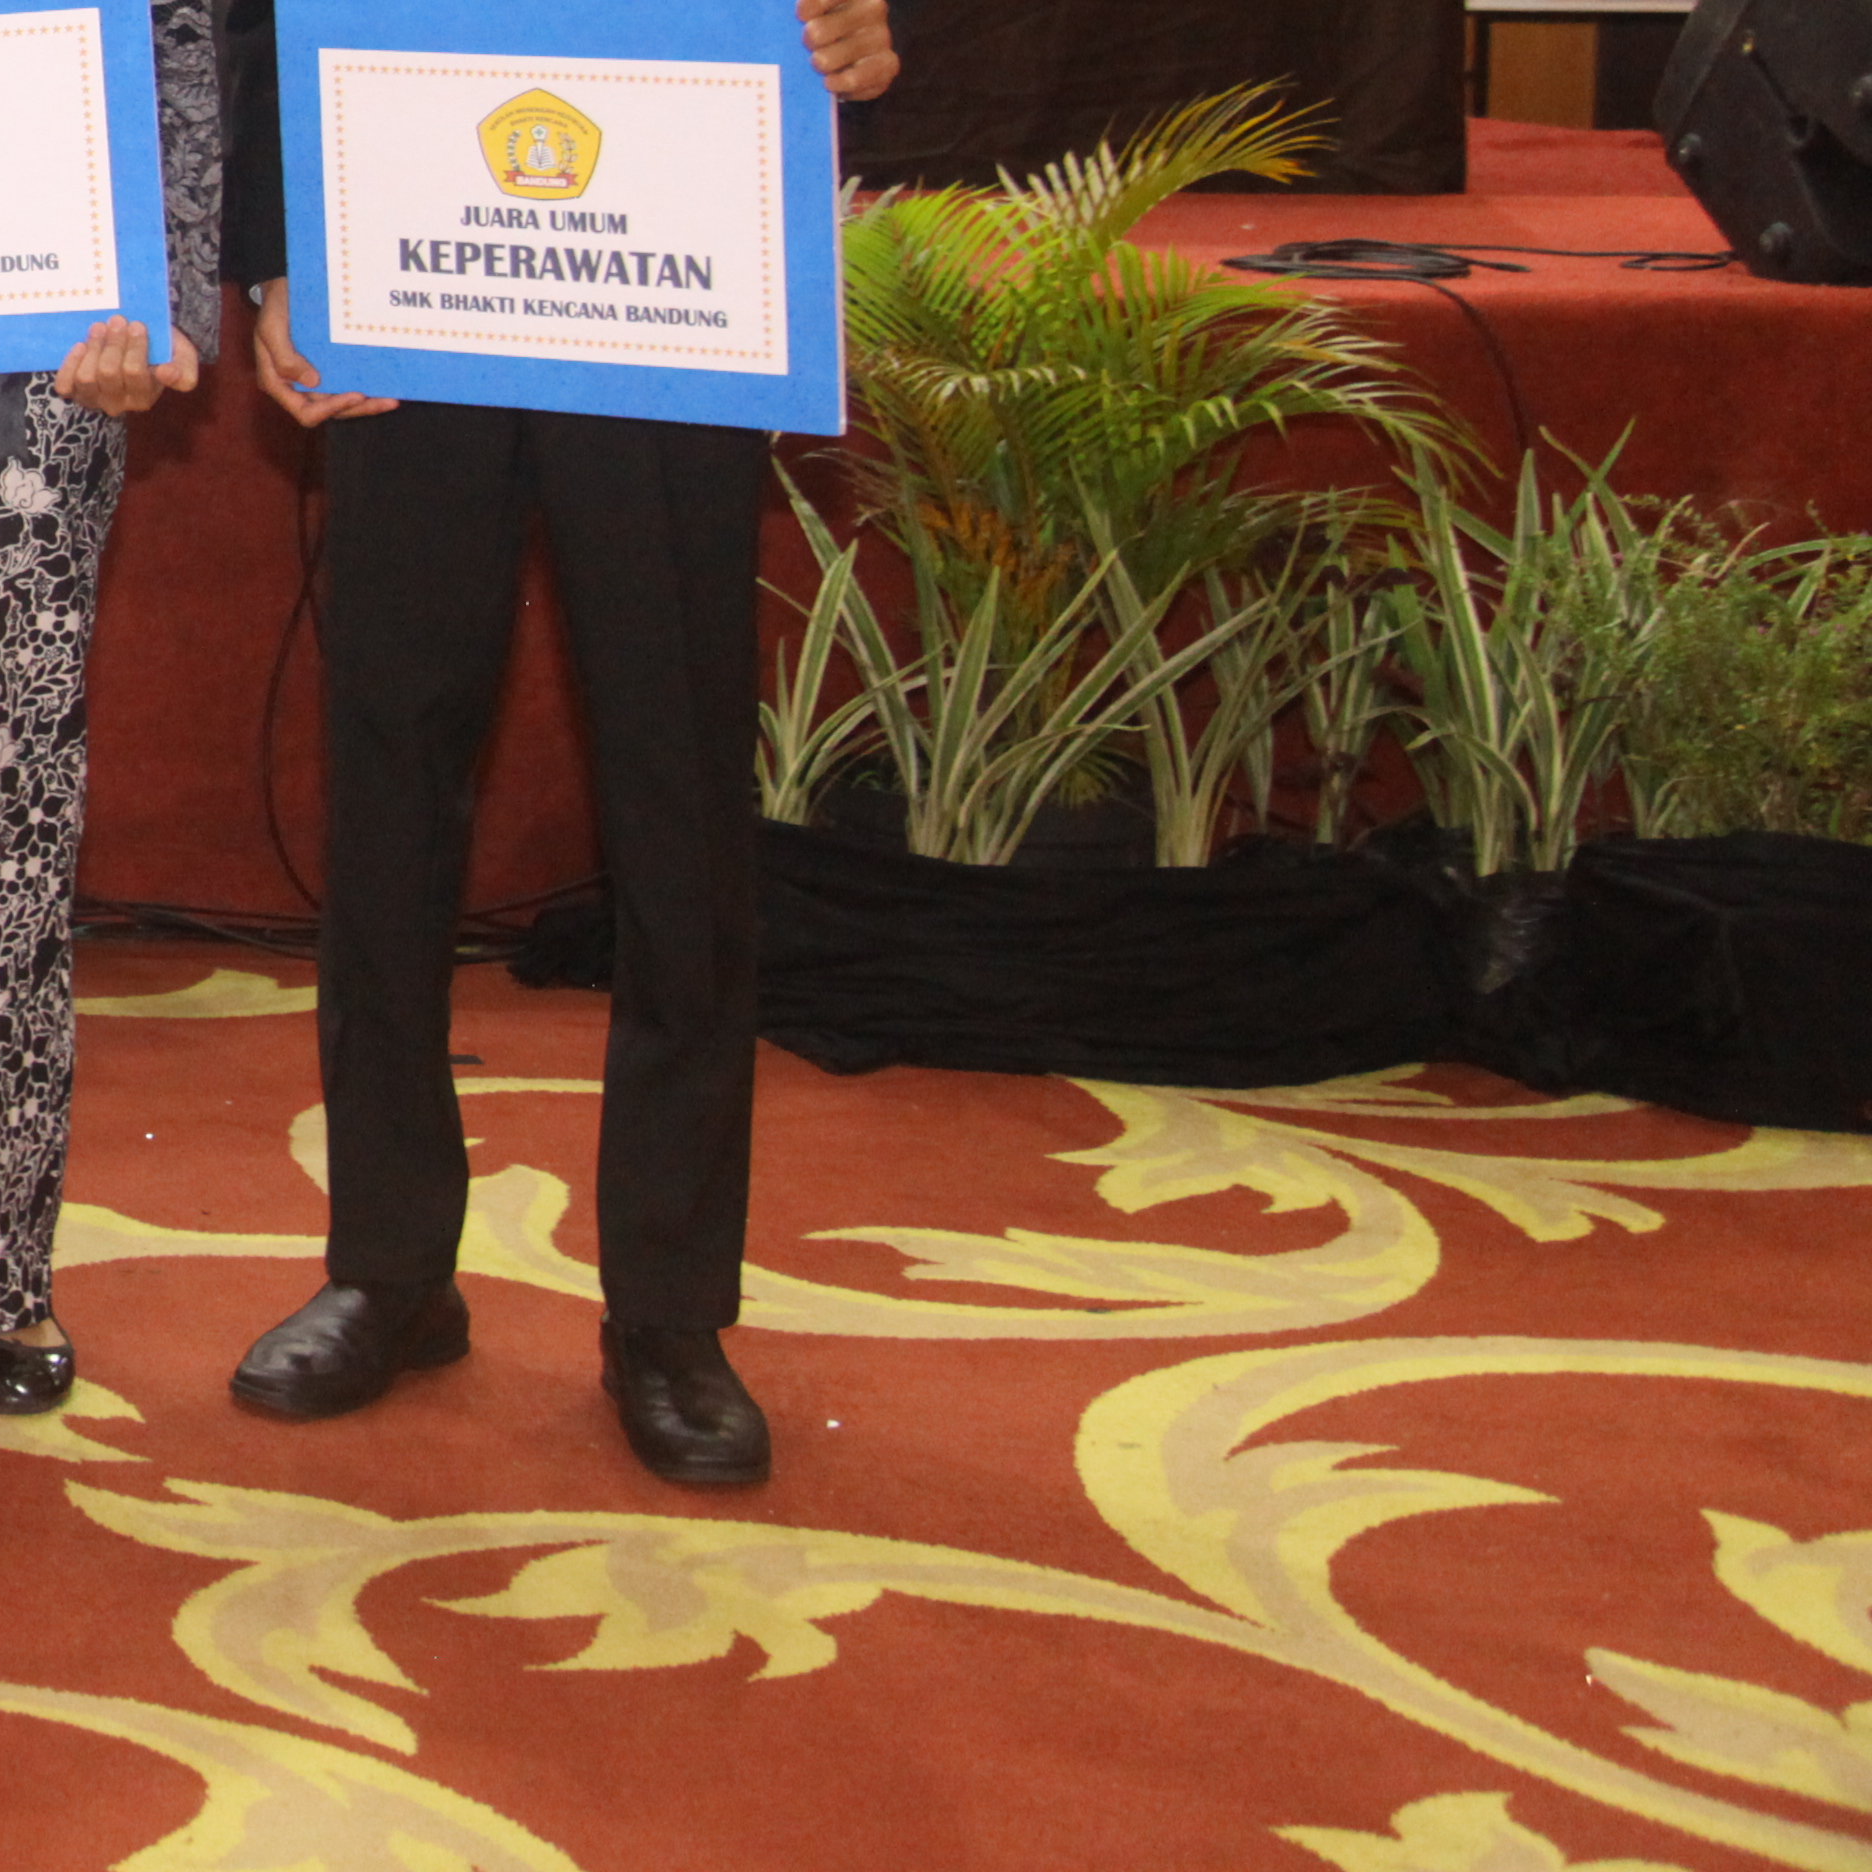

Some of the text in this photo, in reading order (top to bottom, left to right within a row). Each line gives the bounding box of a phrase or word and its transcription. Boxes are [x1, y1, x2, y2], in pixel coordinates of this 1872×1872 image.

[459, 205, 628, 235] JUARA UMUM
[398, 238, 713, 291] KEPERAWATAN
[388, 289, 729, 329] SMK BHAKTI KENCANA BANDUNG
